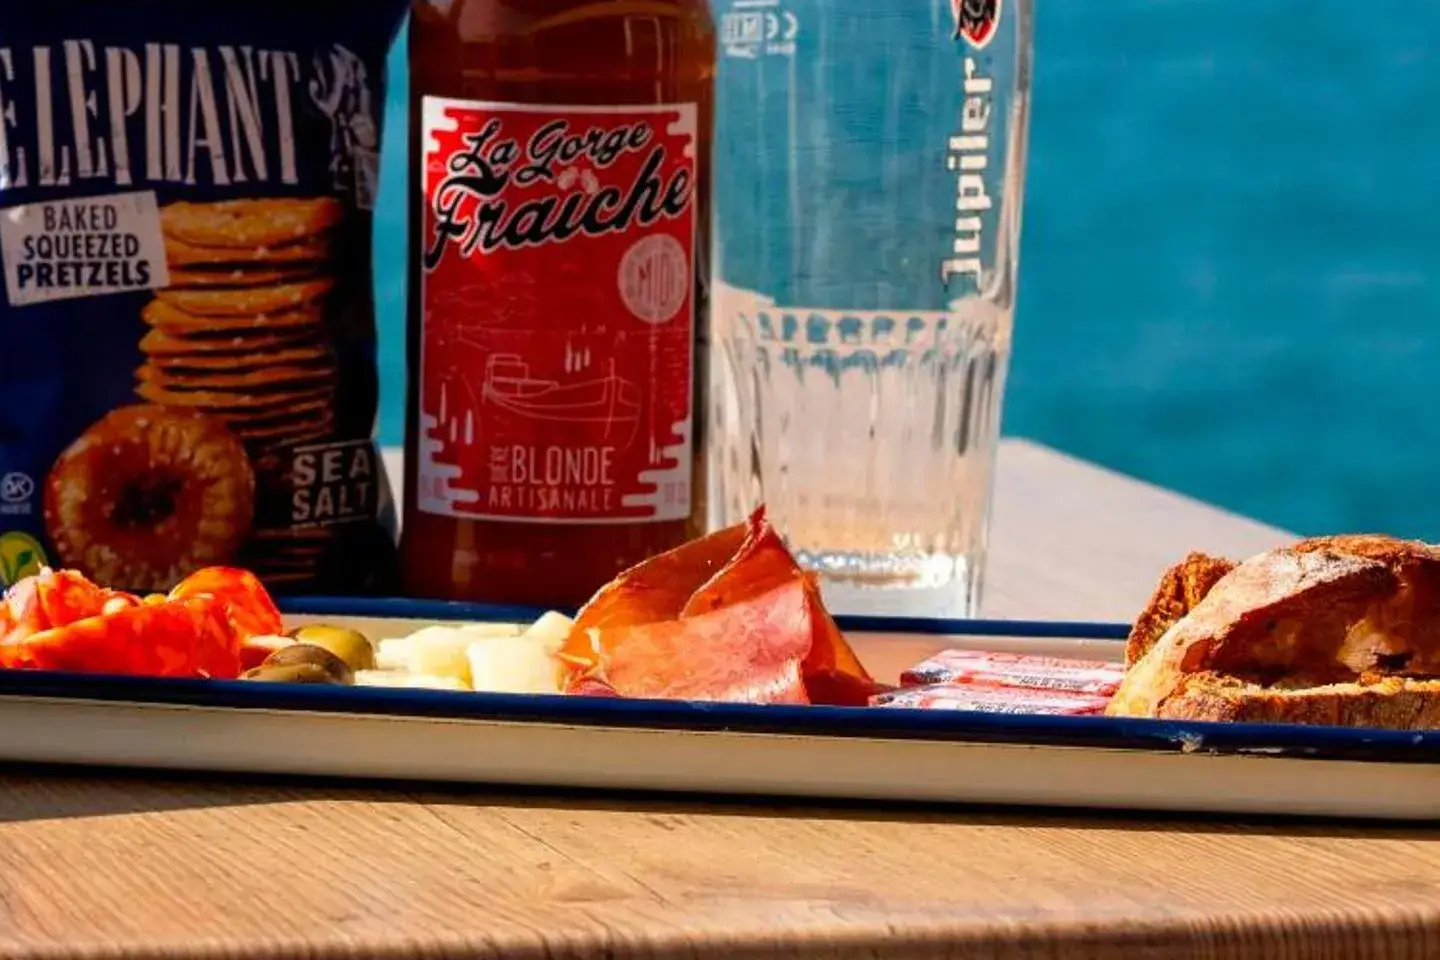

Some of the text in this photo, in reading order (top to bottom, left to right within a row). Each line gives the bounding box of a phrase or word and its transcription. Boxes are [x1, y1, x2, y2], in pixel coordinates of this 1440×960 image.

[448, 118, 651, 183] La Gorge
[941, 57, 993, 292] Jupiler
[43, 203, 117, 231] BAKED
[24, 233, 139, 260] SQUEEZED
[17, 260, 150, 288] PRETZELS
[293, 448, 370, 485] SEA
[512, 445, 616, 485] BLONDE
[292, 482, 372, 520] SALT
[488, 486, 613, 511] ARTISANALE
